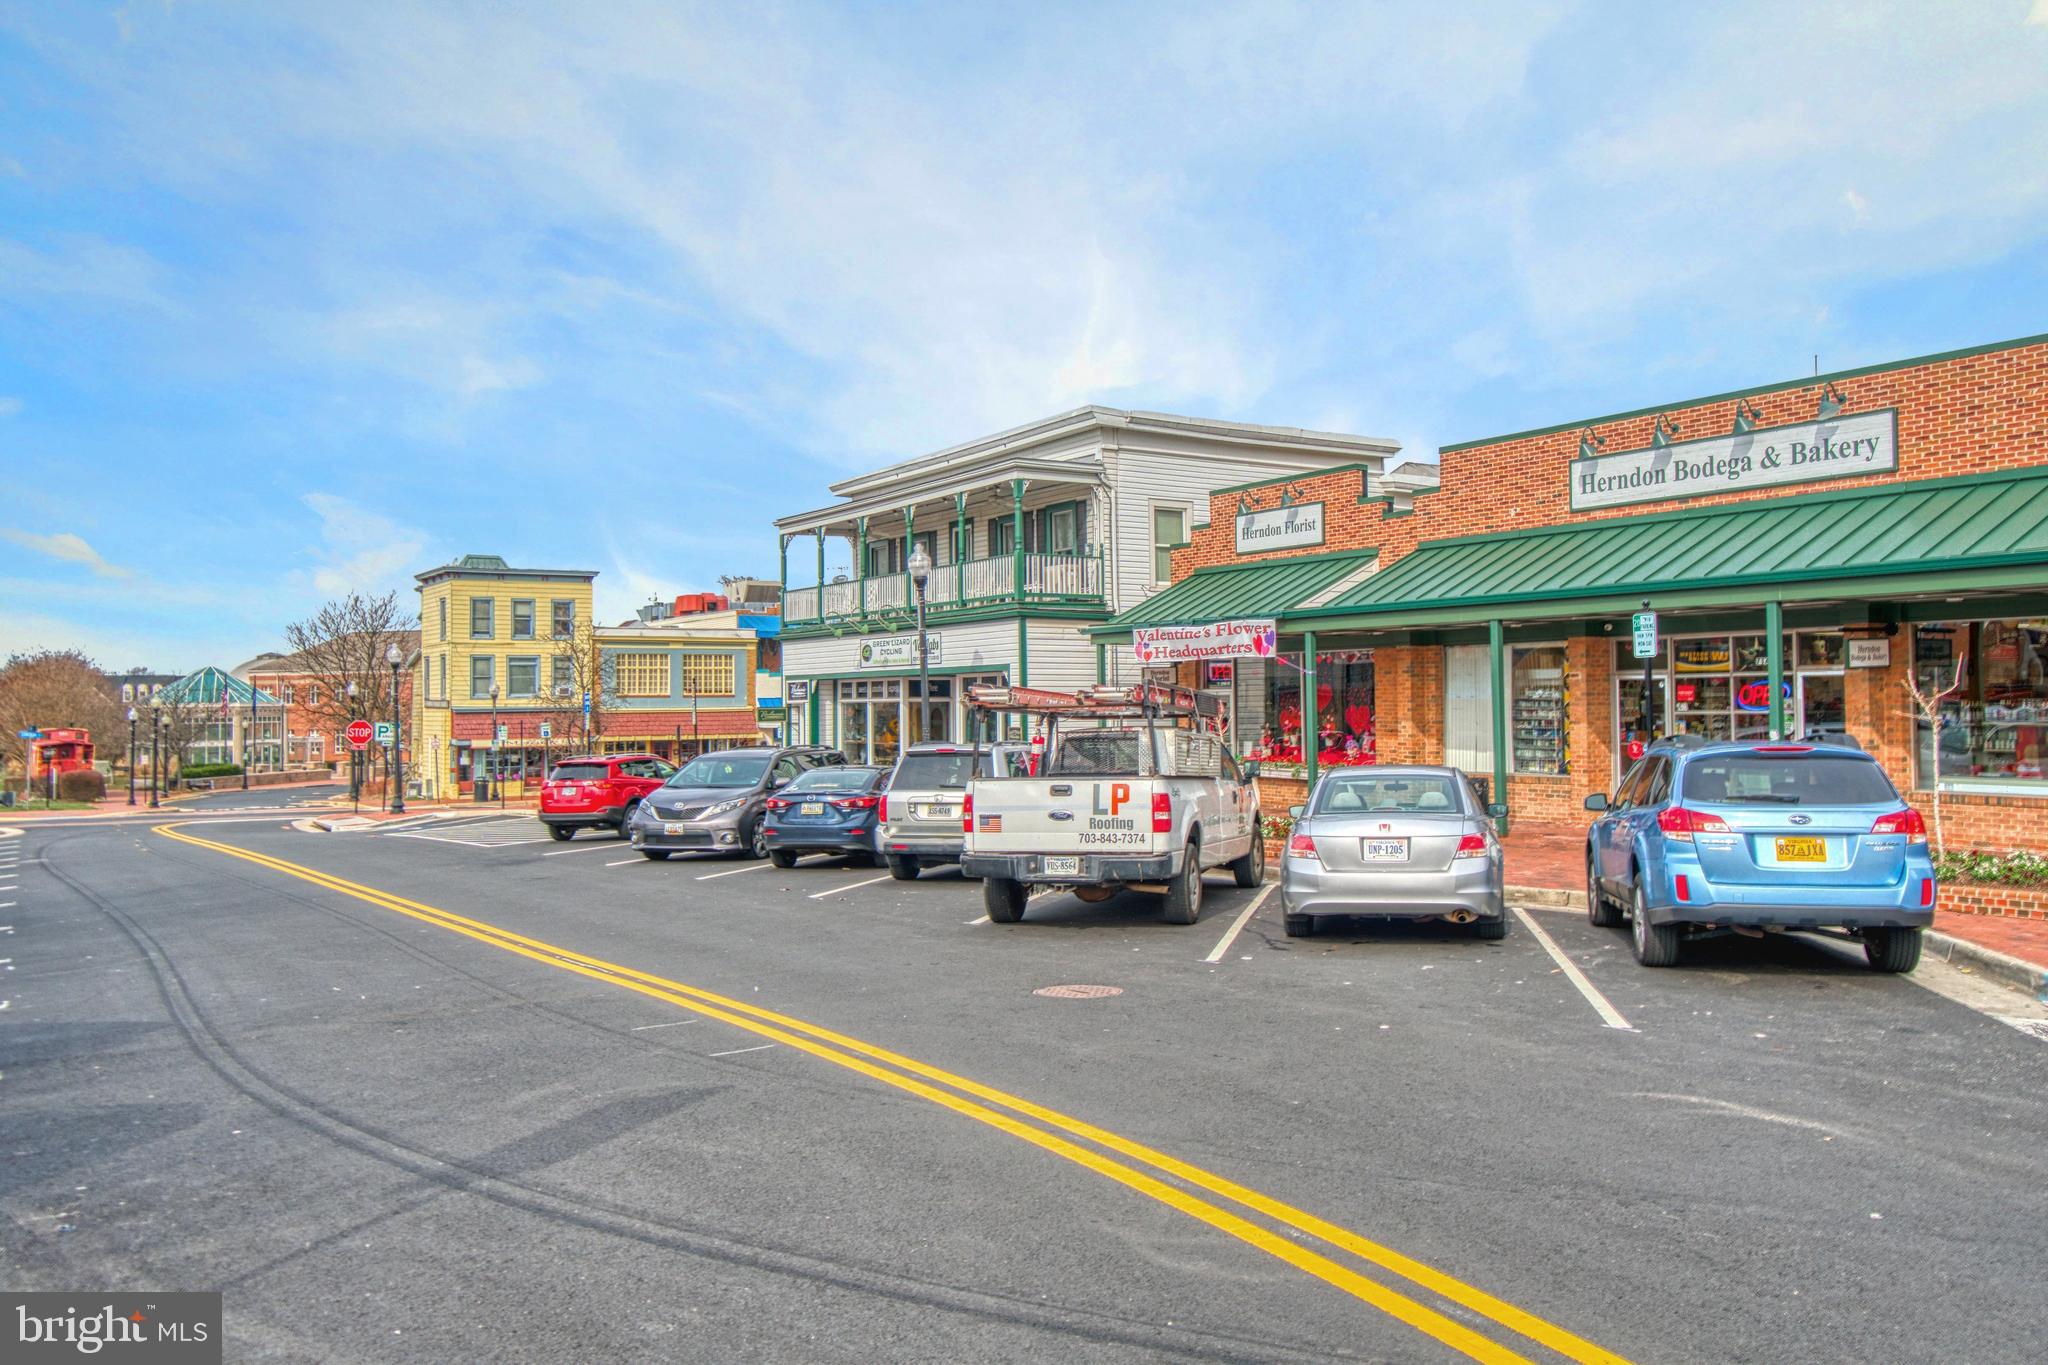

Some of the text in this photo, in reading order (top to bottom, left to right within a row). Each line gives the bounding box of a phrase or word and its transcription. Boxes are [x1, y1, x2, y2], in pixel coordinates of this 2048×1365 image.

[1580, 436, 1880, 495] Herndon Bodega & Bakery
[1242, 518, 1316, 540] Herndon Florist
[1136, 622, 1271, 642] Valentine's Flower
[872, 638, 911, 648] GREEN LIZARD
[880, 648, 903, 656] CYCLING
[1153, 643, 1253, 659] Headquarters
[1739, 684, 1785, 706] OPE
[348, 728, 371, 737] STOP
[1093, 784, 1130, 816] LP
[1089, 817, 1134, 830] Roofing
[1079, 833, 1145, 844] 703-843-7374
[1368, 844, 1404, 855] UNP-1205
